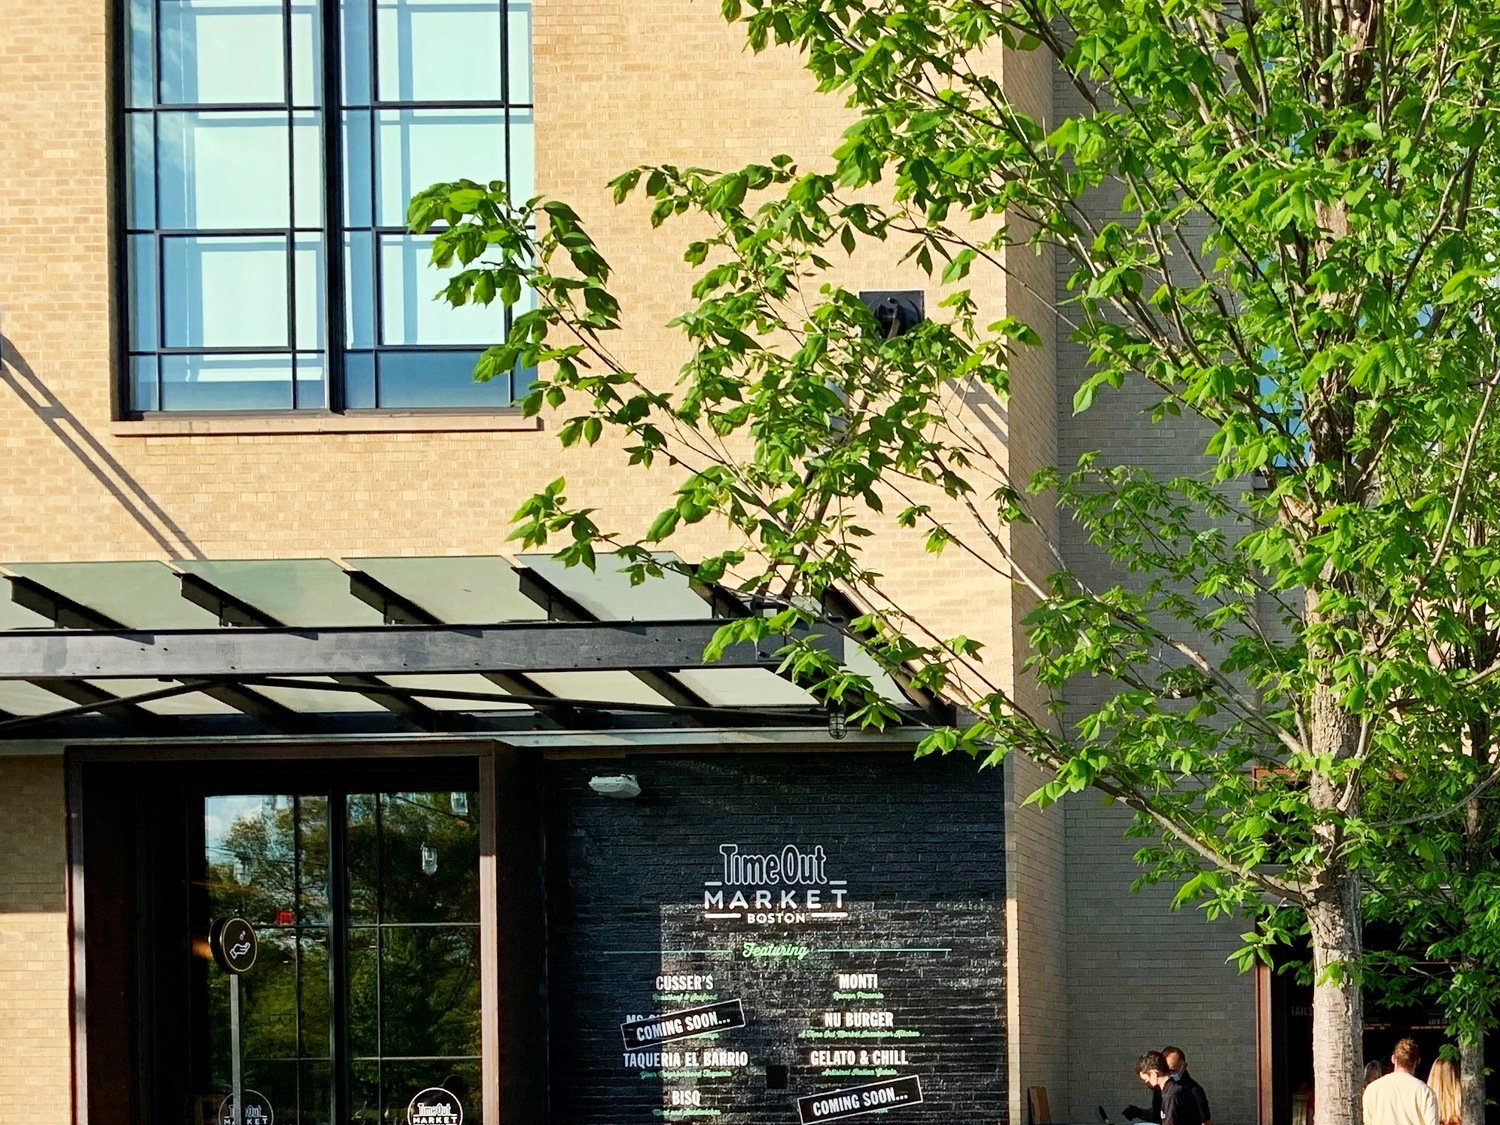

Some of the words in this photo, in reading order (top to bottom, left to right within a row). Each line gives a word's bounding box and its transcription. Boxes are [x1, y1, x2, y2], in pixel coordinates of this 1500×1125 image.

[719, 843, 780, 885] Time
[781, 844, 828, 885] Out
[704, 889, 848, 910] MARKET
[747, 912, 806, 924] BOSTON
[742, 942, 809, 960] Featuring
[655, 974, 714, 991] CUSSER'S
[839, 973, 878, 989] MONTI
[636, 1018, 684, 1042] COMING
[685, 1010, 731, 1032] SOON...
[824, 1012, 841, 1028] NU
[845, 1012, 894, 1028] BURGER
[623, 1052, 681, 1069] TAQUERIA
[685, 1051, 700, 1067] EL
[703, 1051, 749, 1067] BARRIO
[810, 1050, 856, 1065] GELATO
[860, 1050, 870, 1065] &
[872, 1050, 909, 1065] CHILL
[671, 1090, 701, 1106] BISQ
[812, 1095, 861, 1117] COMING
[863, 1086, 909, 1107] SOON...
[223, 1118, 268, 1125] MKET
